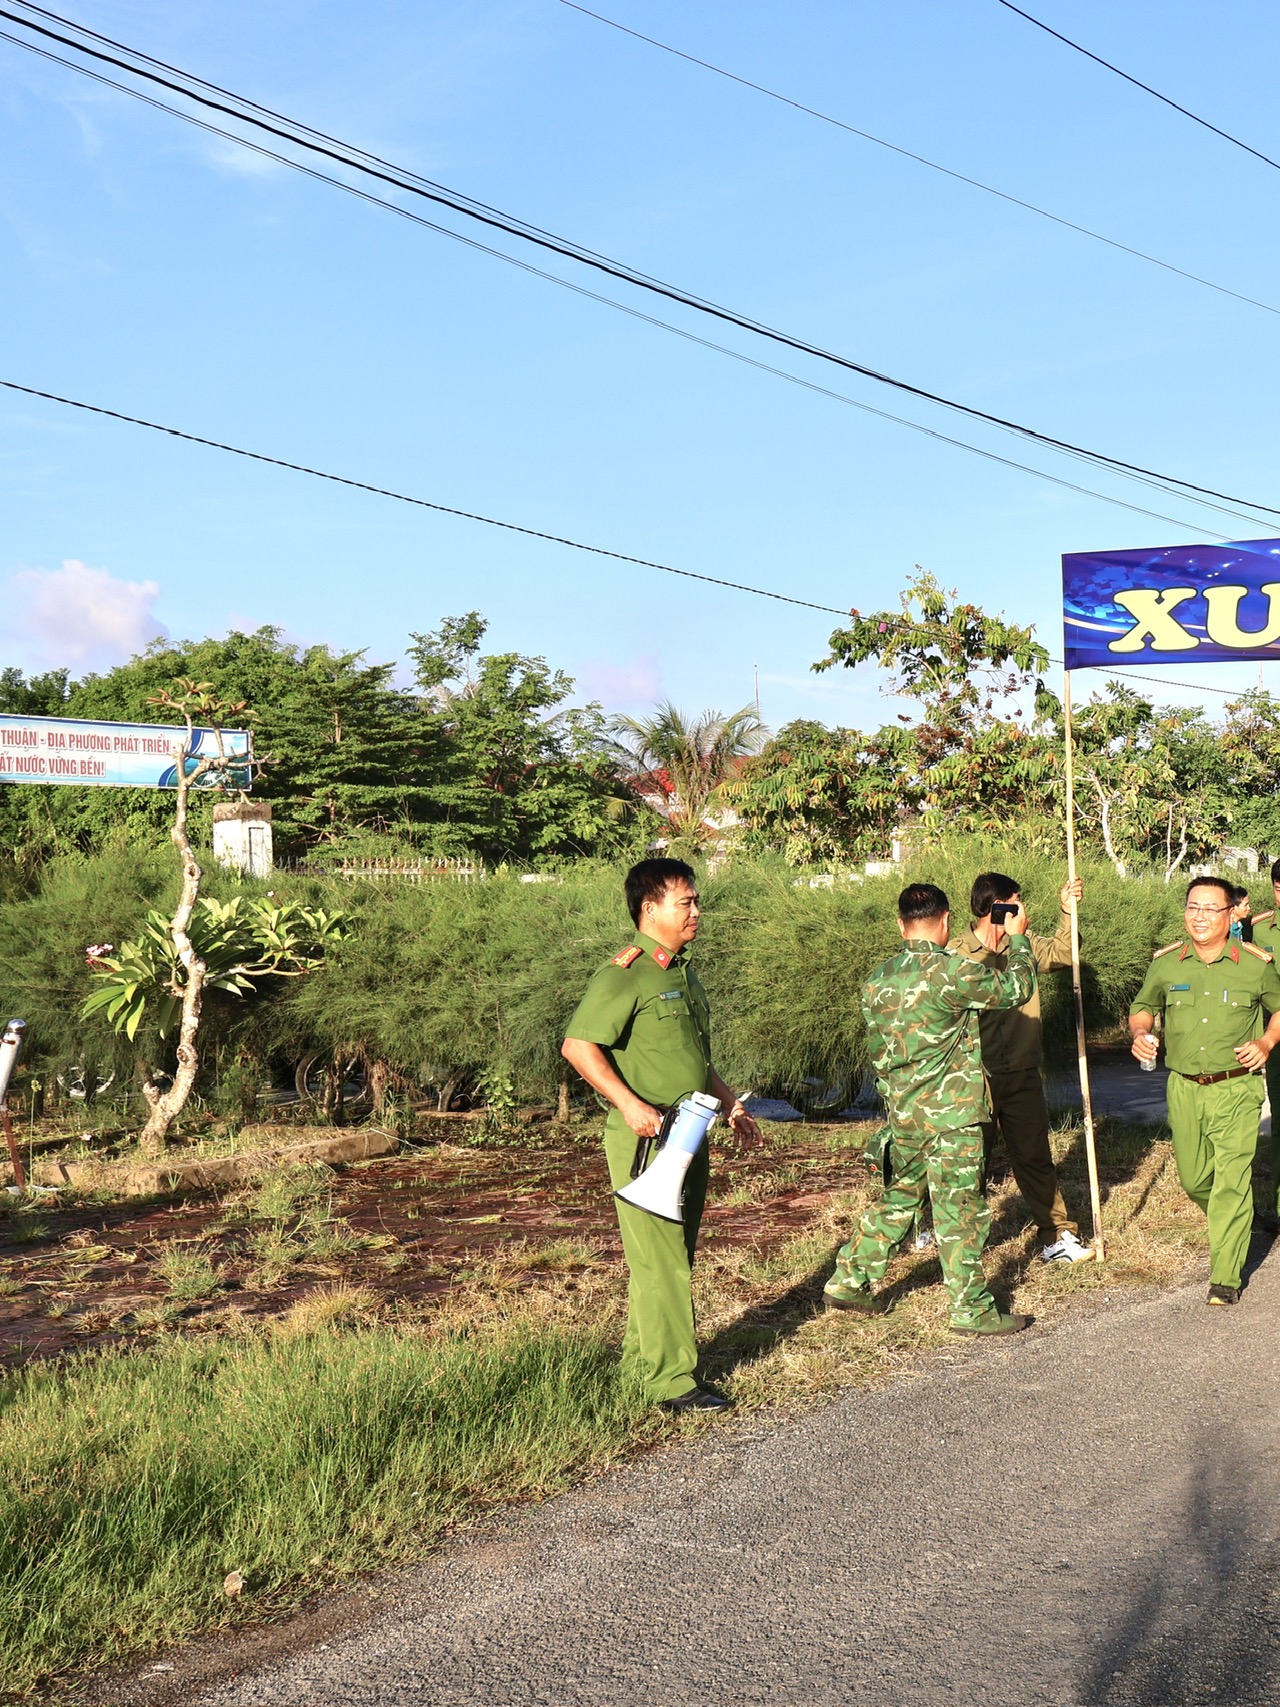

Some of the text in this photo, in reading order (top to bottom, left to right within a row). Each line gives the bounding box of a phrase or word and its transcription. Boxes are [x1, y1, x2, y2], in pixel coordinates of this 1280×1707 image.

[1, 728, 37, 749] THUẬN
[47, 732, 66, 751] ĐỊA
[69, 733, 111, 751] PHƯƠNG
[114, 734, 139, 752] PHÁT
[16, 754, 45, 774] NƯỚC
